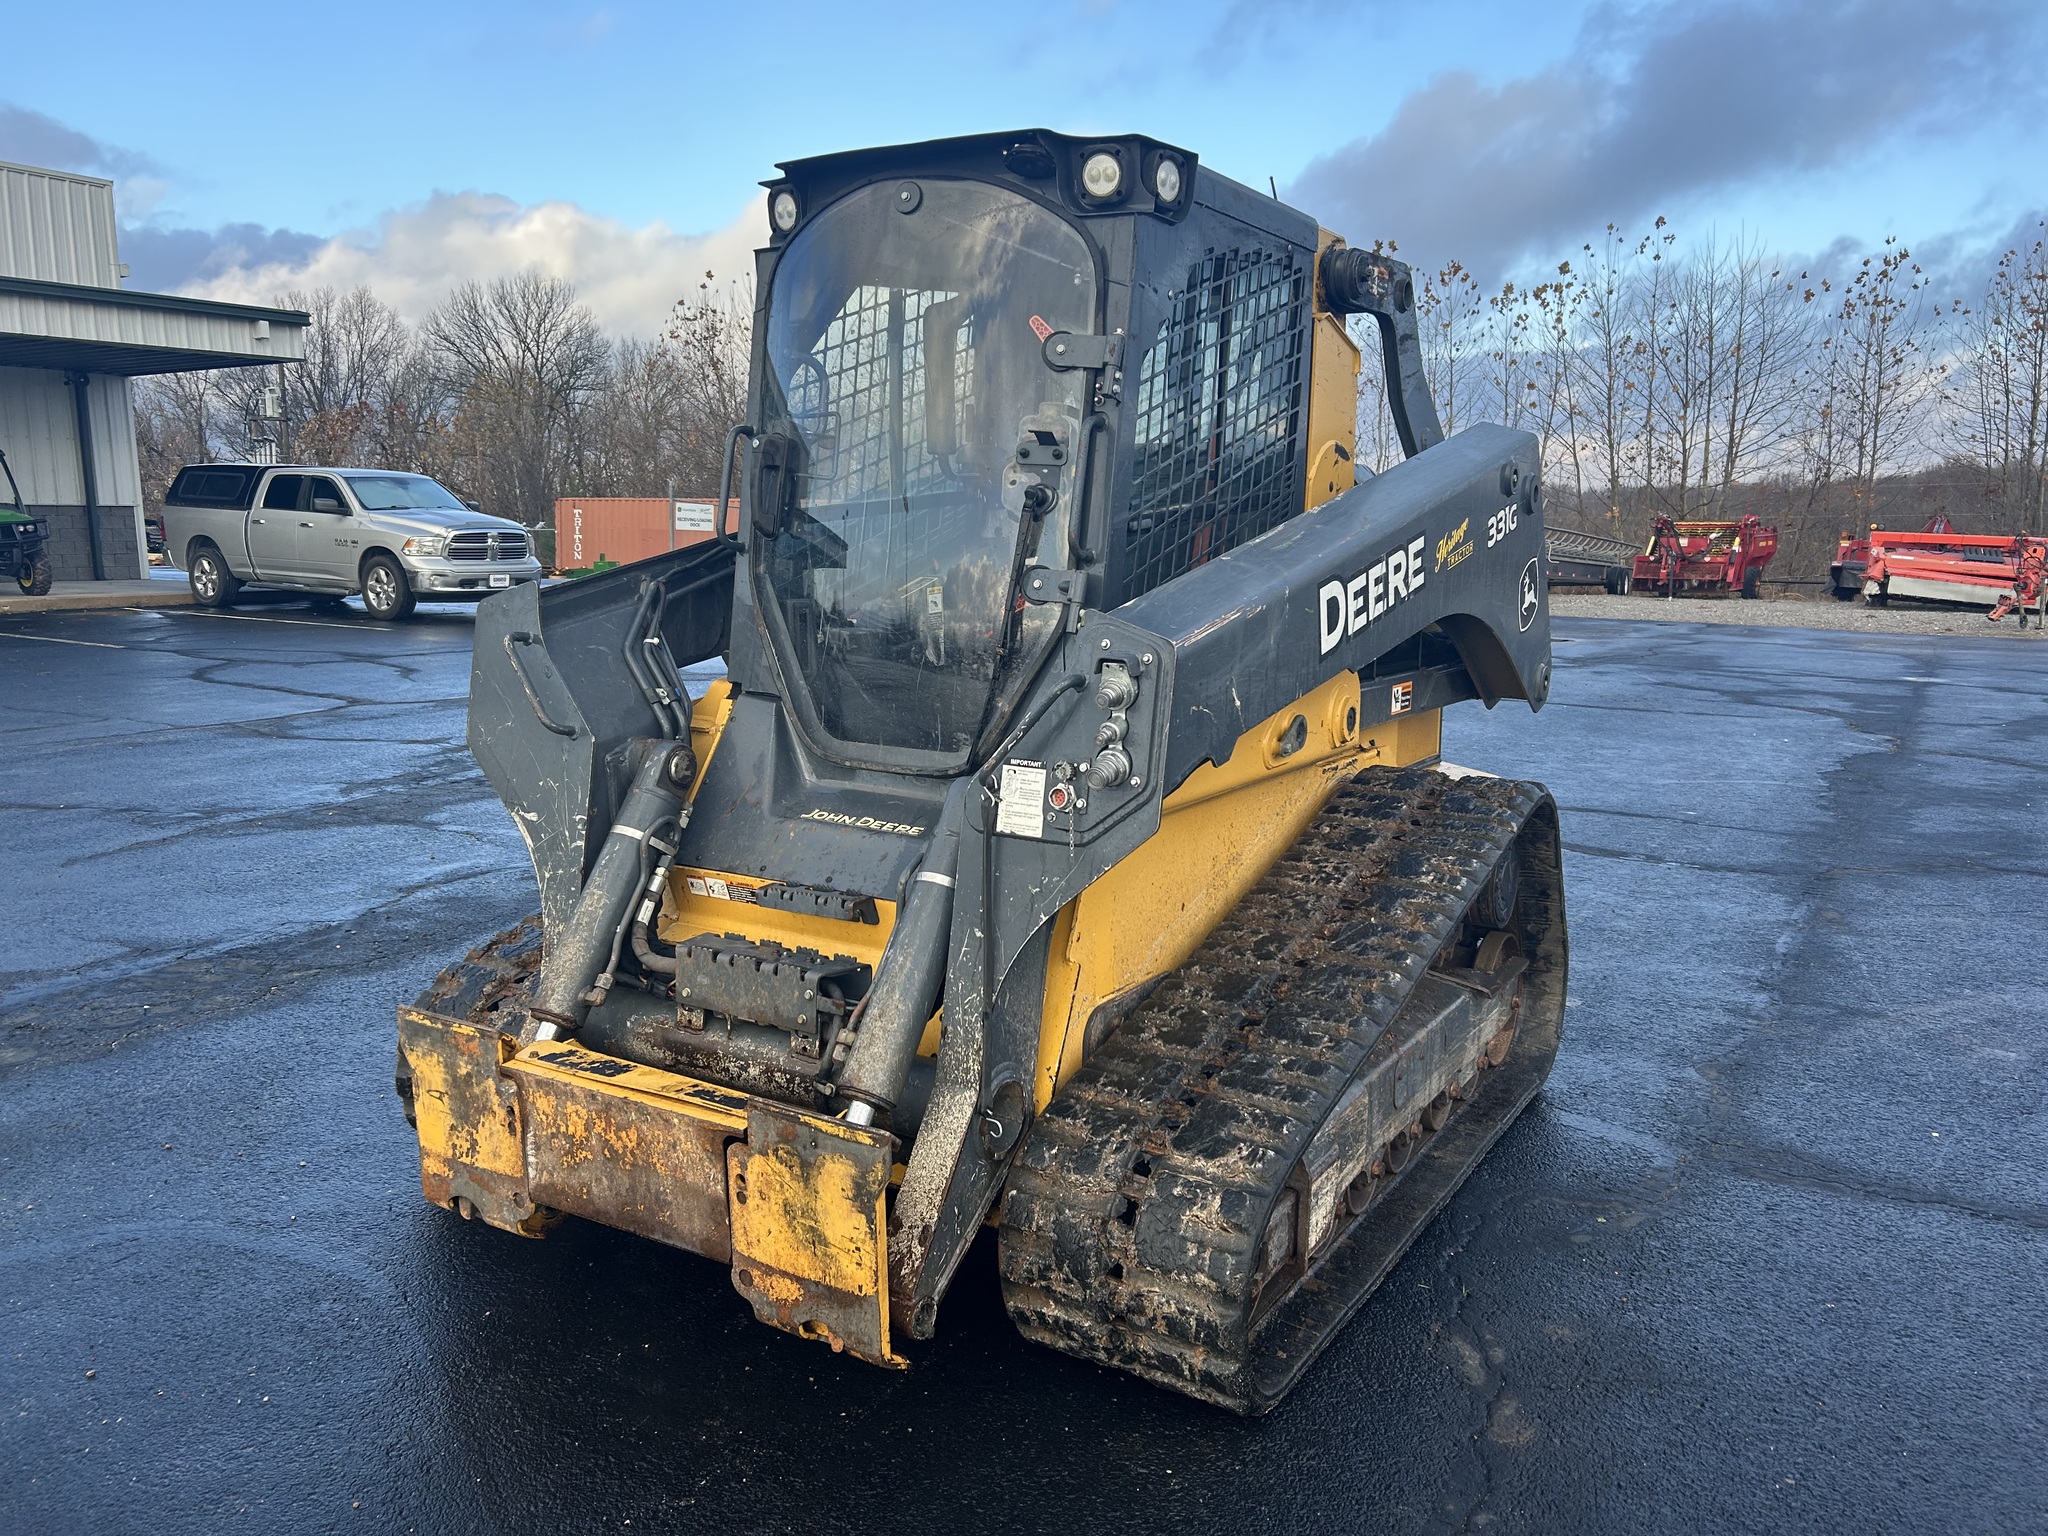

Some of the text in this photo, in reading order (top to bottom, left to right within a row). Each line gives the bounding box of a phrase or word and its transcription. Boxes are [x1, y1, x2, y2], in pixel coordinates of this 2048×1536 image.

[573, 509, 582, 560] TRITON
[1434, 517, 1469, 573] Heritage
[1487, 503, 1518, 548] 331G
[1447, 542, 1474, 568] TRACTOR
[1319, 535, 1425, 656] DEERE
[1010, 758, 1043, 768] IMPORTANT
[800, 809, 925, 837] JOHN DEERE
